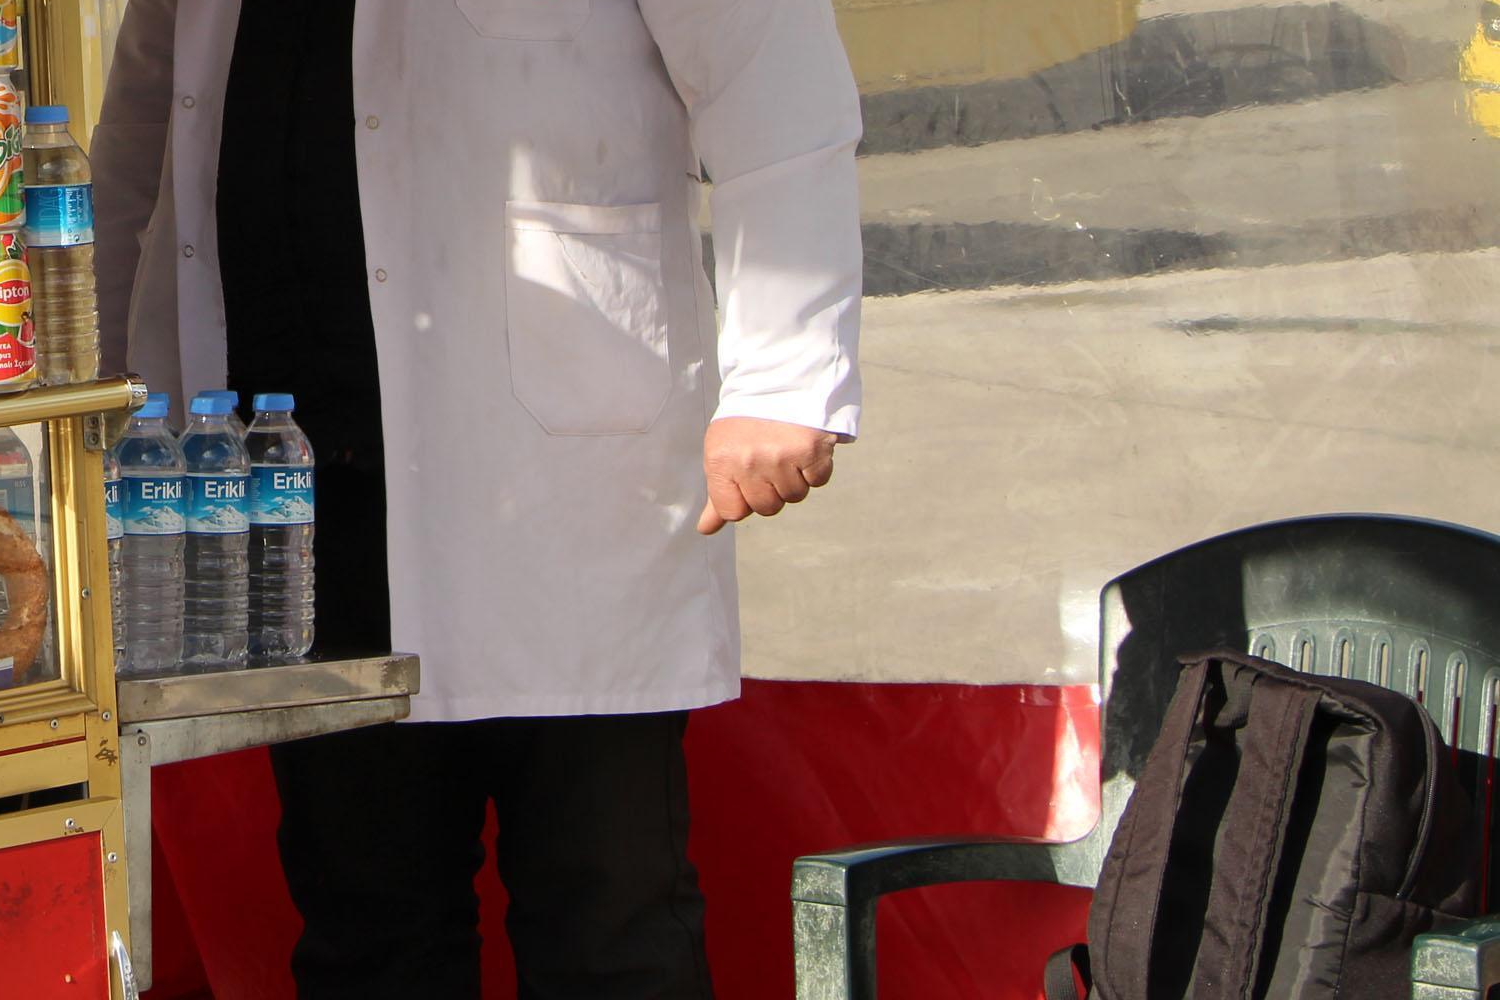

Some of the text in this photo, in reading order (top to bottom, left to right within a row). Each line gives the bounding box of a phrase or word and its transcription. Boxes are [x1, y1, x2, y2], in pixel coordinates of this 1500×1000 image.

[141, 481, 182, 500] Erikli
[204, 481, 245, 500] Erikli
[274, 472, 312, 490] Erikli
